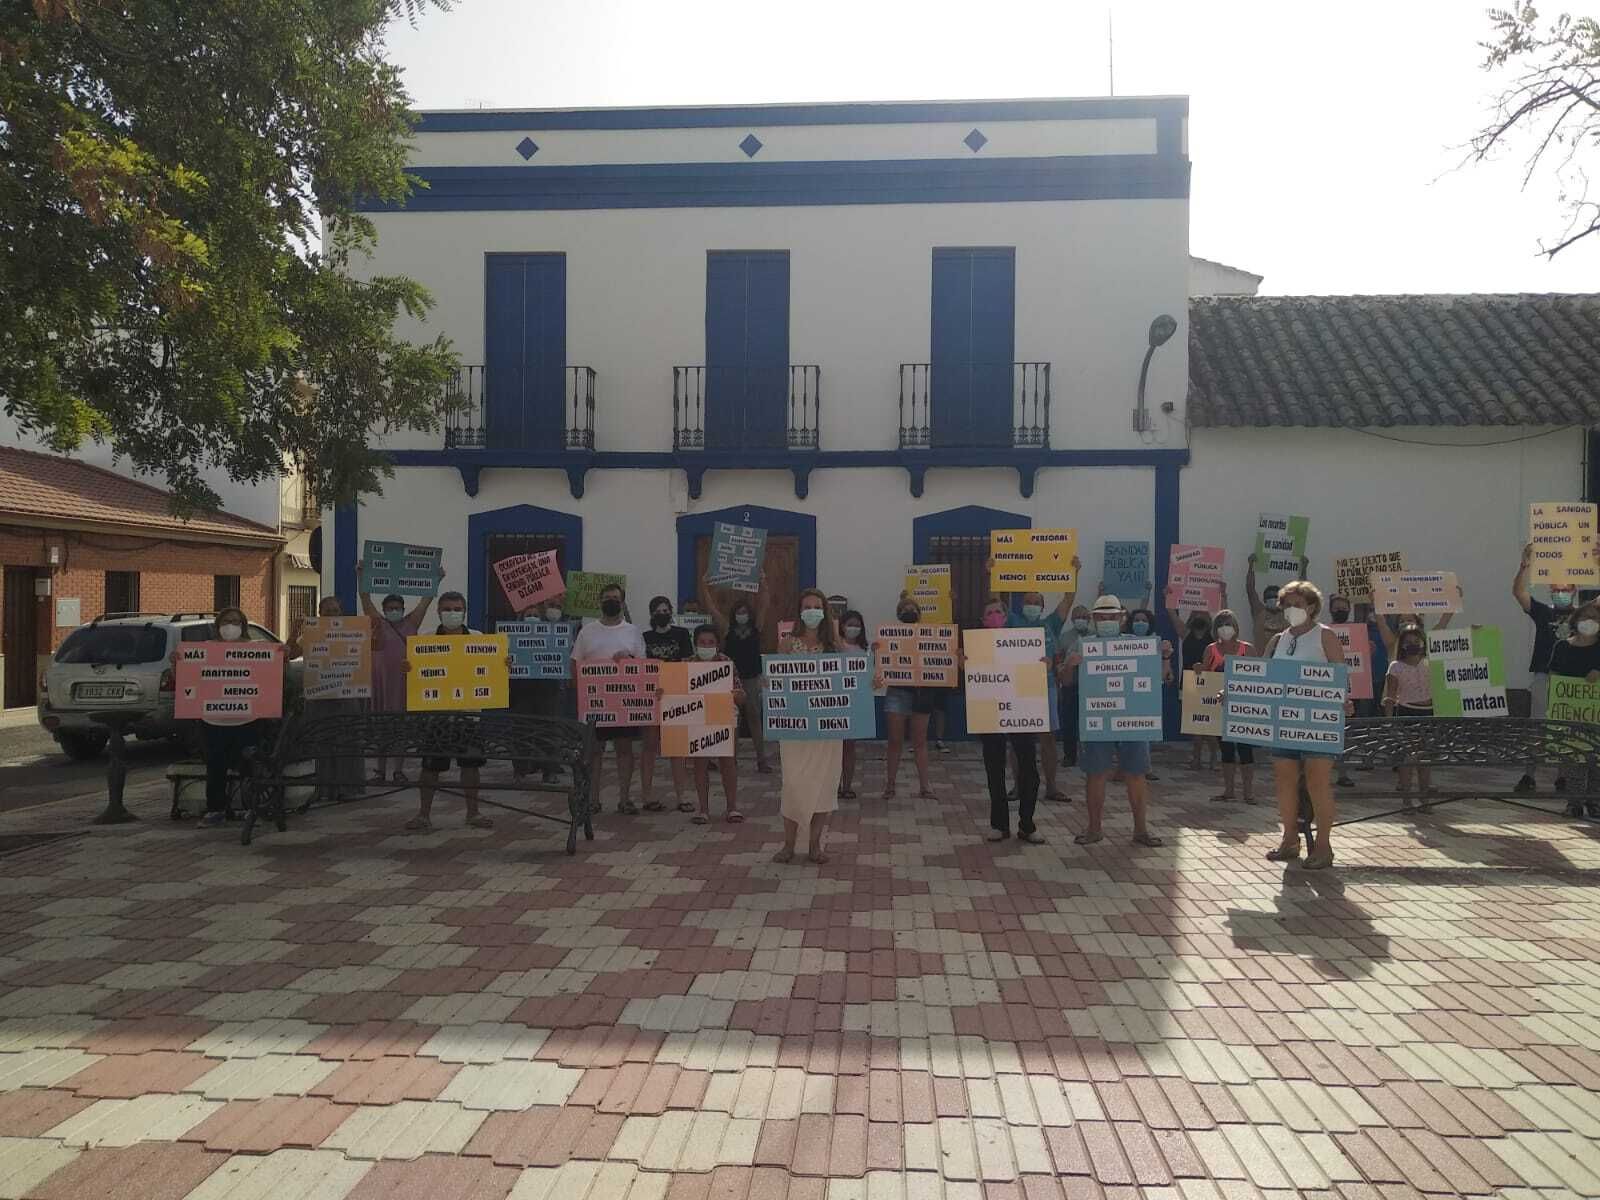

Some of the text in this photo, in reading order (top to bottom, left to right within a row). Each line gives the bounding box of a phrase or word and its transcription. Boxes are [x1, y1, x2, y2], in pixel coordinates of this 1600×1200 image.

[744, 512, 750, 521] 2
[1534, 521, 1568, 529] PÚBLICA
[997, 535, 1013, 543] MÁS
[1272, 538, 1293, 551] sanidad
[1105, 545, 1149, 555] SANIDAD
[1389, 552, 1401, 562] QUE
[1270, 560, 1298, 572] matan
[1538, 568, 1594, 576] DE TODAS
[499, 625, 530, 633] OCHAVILO
[537, 625, 549, 633] DEL
[880, 628, 913, 637] OCHAVILO
[920, 628, 932, 637] DEL
[890, 642, 947, 651] EN DEFENSA
[996, 639, 1042, 648] SANIDAD
[1114, 643, 1149, 651] SANIDAD
[1429, 636, 1469, 653] Los recortes
[184, 648, 271, 660] MÁS PERSONAL
[416, 644, 450, 654] QUEREMOS
[770, 658, 866, 674] OCHAVILO DEL RÍO
[881, 656, 953, 666] DE UNA SANIDAD
[477, 667, 486, 676] DE
[582, 665, 618, 676] OCHAVILO
[625, 665, 639, 675] DEL
[1096, 663, 1128, 672] PÚBLICA
[1235, 663, 1330, 679] POR UNA
[1447, 662, 1489, 682] en sanidad
[201, 669, 250, 678] SANITARIO
[689, 664, 731, 691] SANIDAD
[923, 672, 945, 681] DIGNA
[967, 672, 1010, 683] PÚBLICA
[772, 677, 857, 691] EN DEFENSA DE
[1197, 677, 1205, 686] La
[185, 687, 258, 696] Y MENOS
[455, 688, 461, 697] A
[587, 683, 656, 694] EN DEFENSA DE
[1228, 683, 1283, 696] SANIDAD
[1286, 685, 1342, 700] PÚBLICA
[206, 703, 249, 712] EXCUSAS
[590, 698, 654, 708] UNA SANIDAD
[768, 696, 849, 709] UNA SANIDAD
[999, 702, 1013, 711] DE
[1091, 701, 1117, 709] VENDE
[1463, 694, 1506, 711] matan
[662, 699, 704, 721] PÚBLICA
[1231, 704, 1338, 722] DIGNA EN LAS
[629, 712, 652, 722] DIGNA
[1193, 713, 1210, 722] para
[820, 718, 849, 730] DIGNA
[999, 717, 1044, 728] CALIDAD
[1089, 720, 1155, 728] SE DEFIENDE
[1229, 724, 1339, 742] ZONAS RURALES
[689, 728, 730, 755] DE CALIDAD
